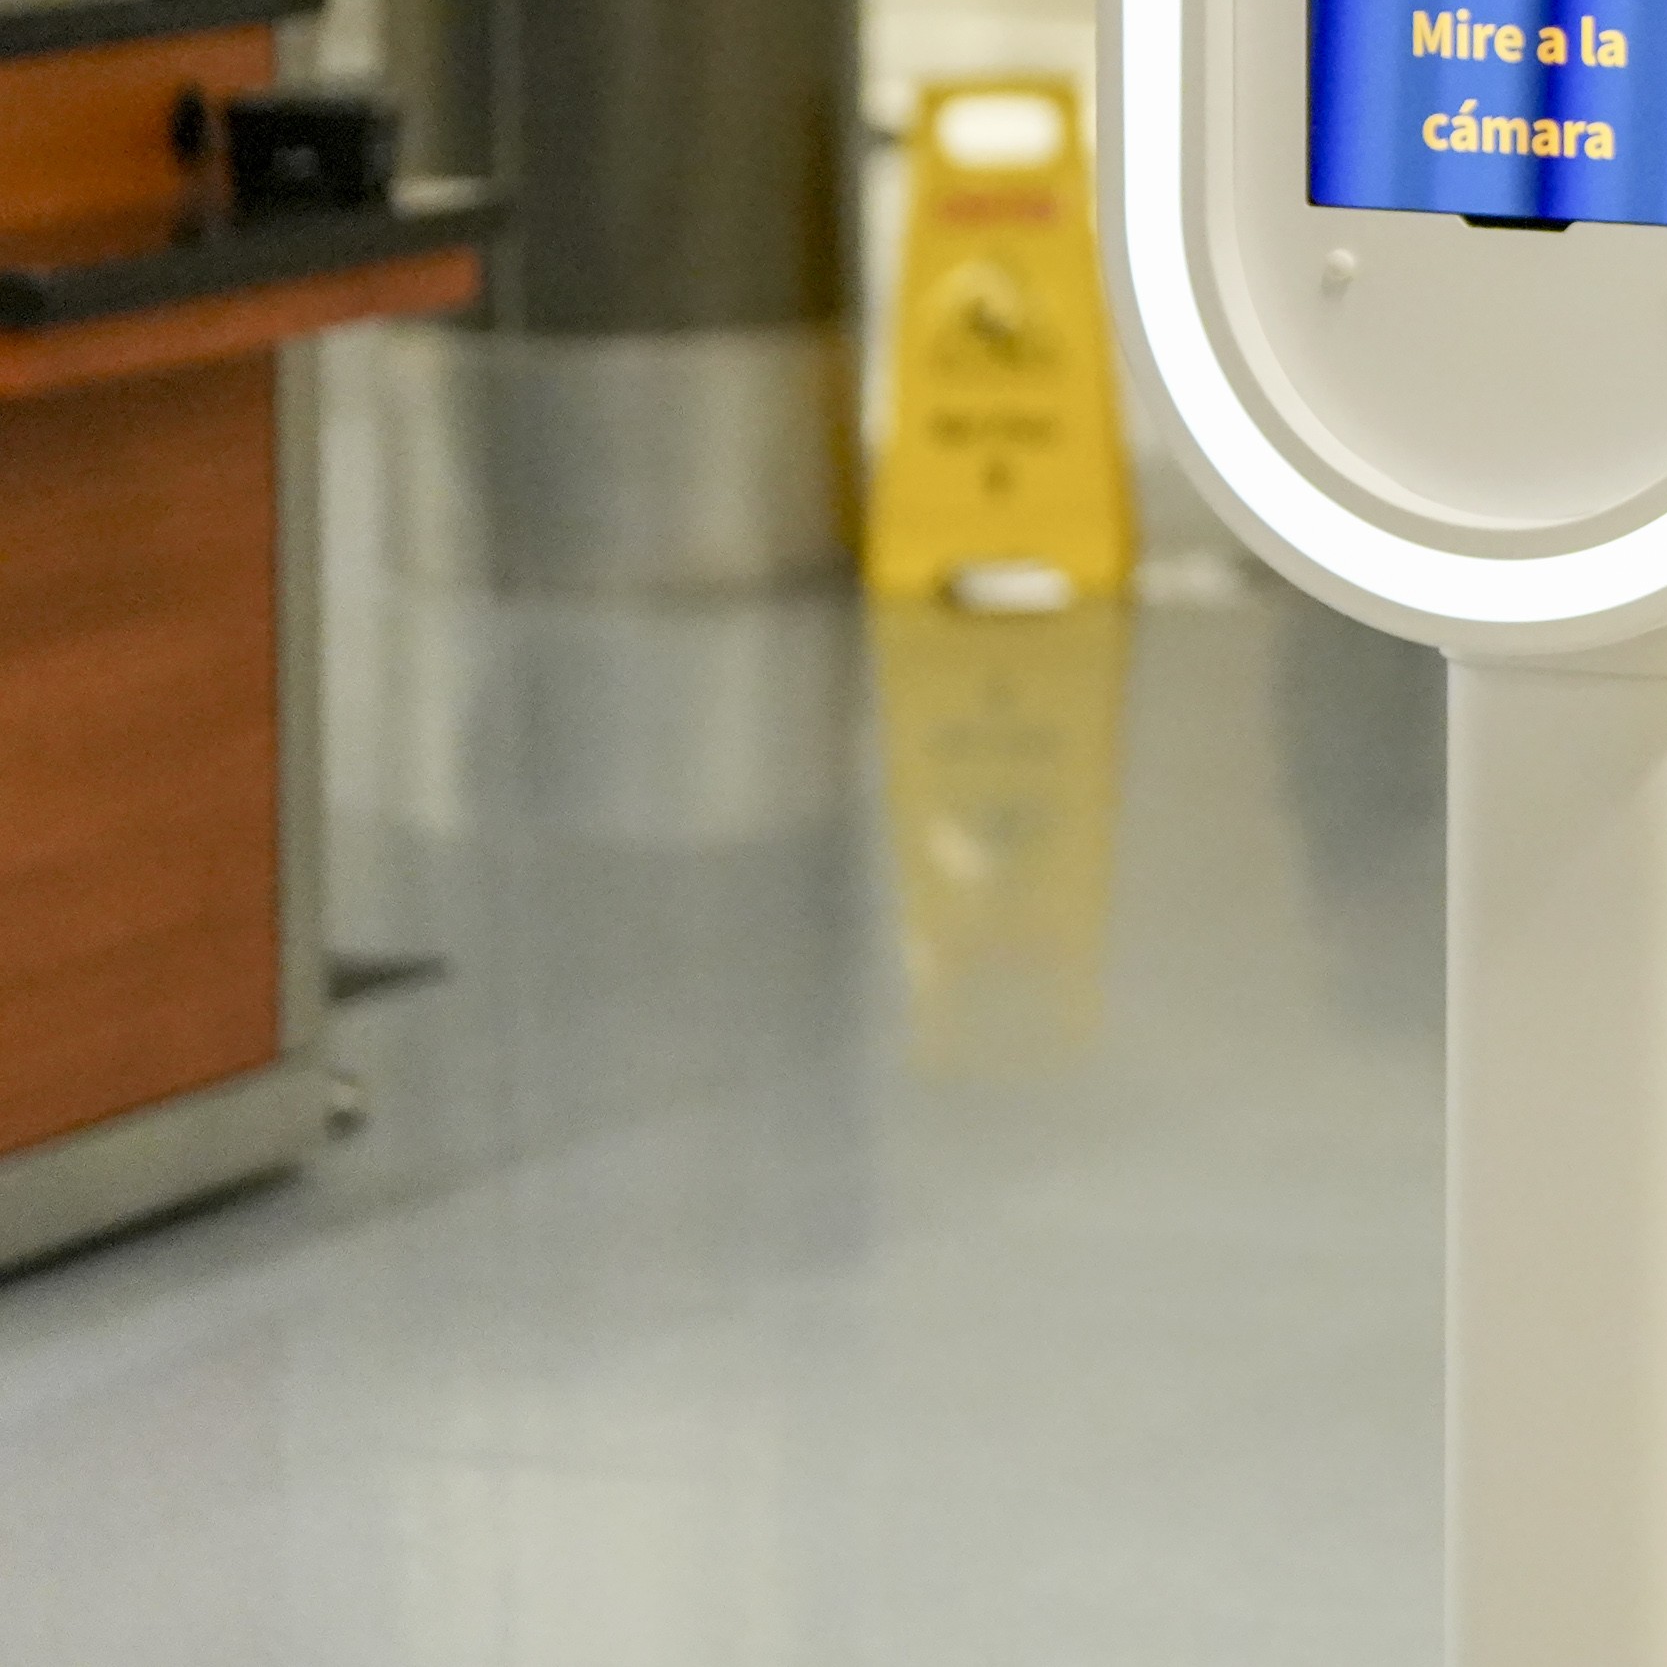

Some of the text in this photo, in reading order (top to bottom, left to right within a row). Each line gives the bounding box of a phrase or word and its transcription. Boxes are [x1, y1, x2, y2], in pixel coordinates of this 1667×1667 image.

[1412, 8, 1628, 68] Mire a la
[1422, 98, 1616, 160] cámara
